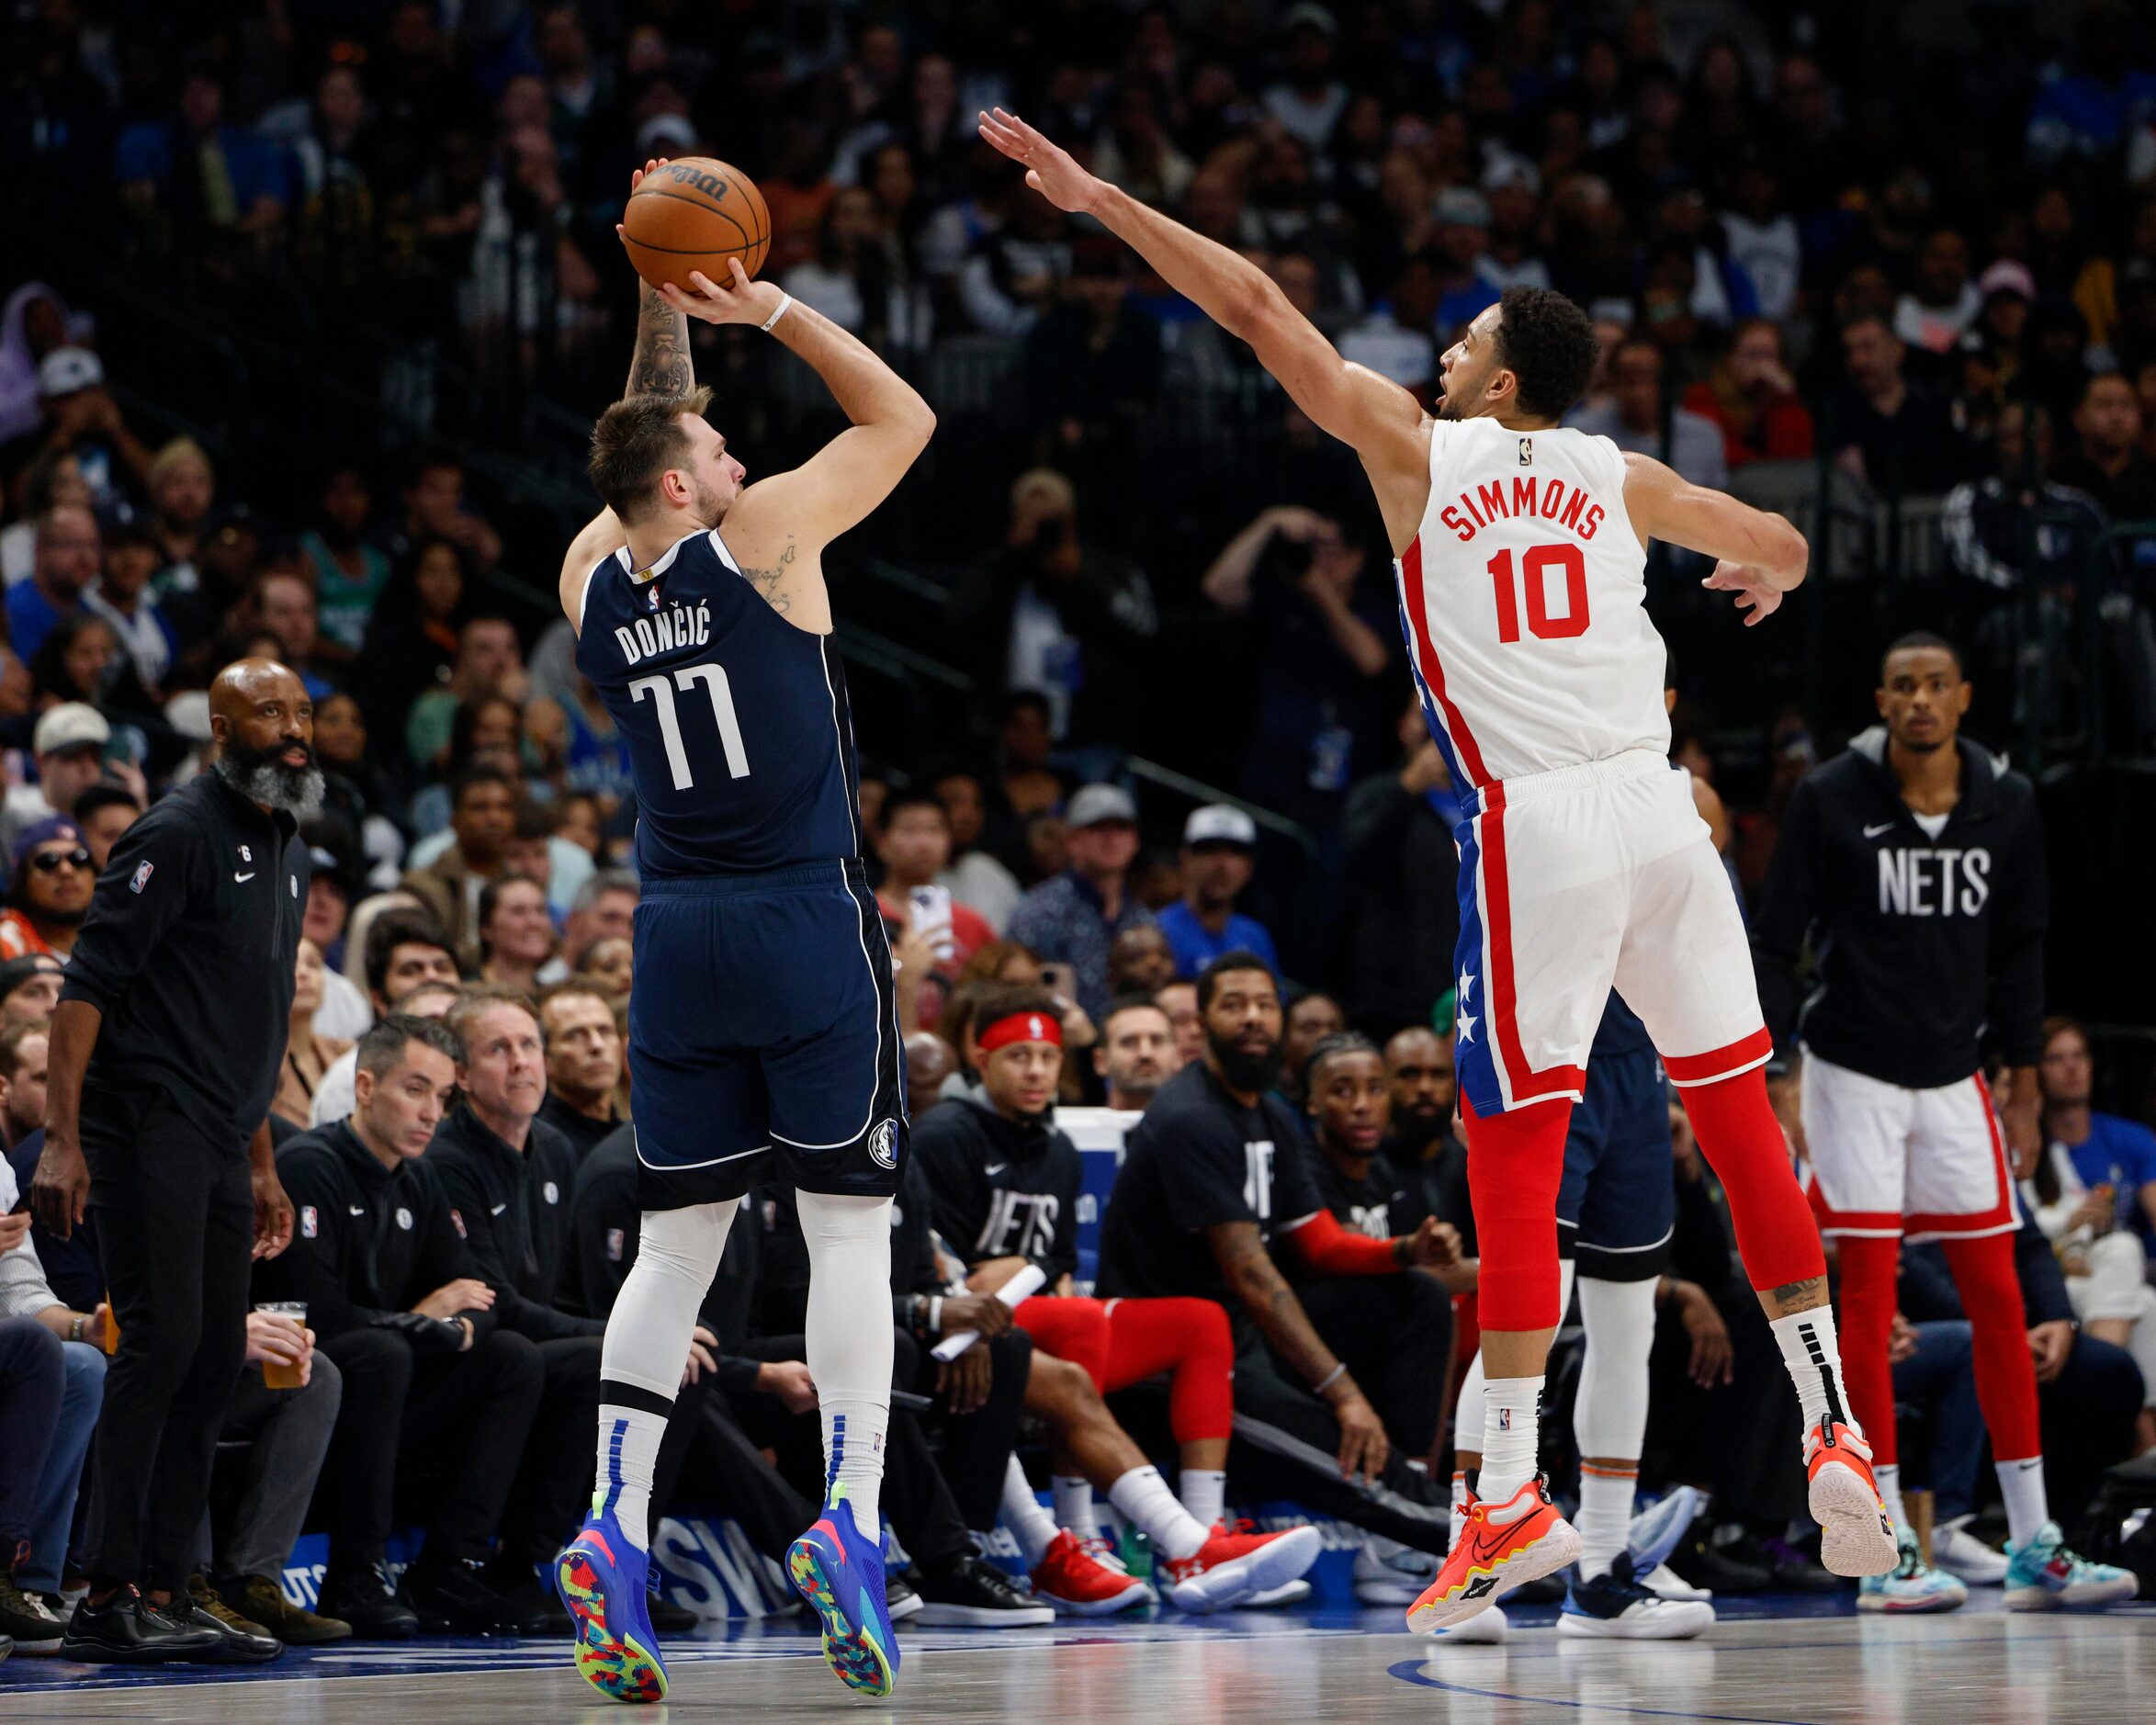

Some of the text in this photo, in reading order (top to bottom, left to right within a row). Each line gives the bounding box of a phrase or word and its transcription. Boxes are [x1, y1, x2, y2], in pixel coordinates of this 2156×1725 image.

[1440, 477, 1605, 541] SIMMONS
[1486, 543, 1590, 643] 10
[615, 598, 710, 665] DONČIĆ
[627, 662, 751, 791] 77
[1877, 847, 1992, 917] NETS
